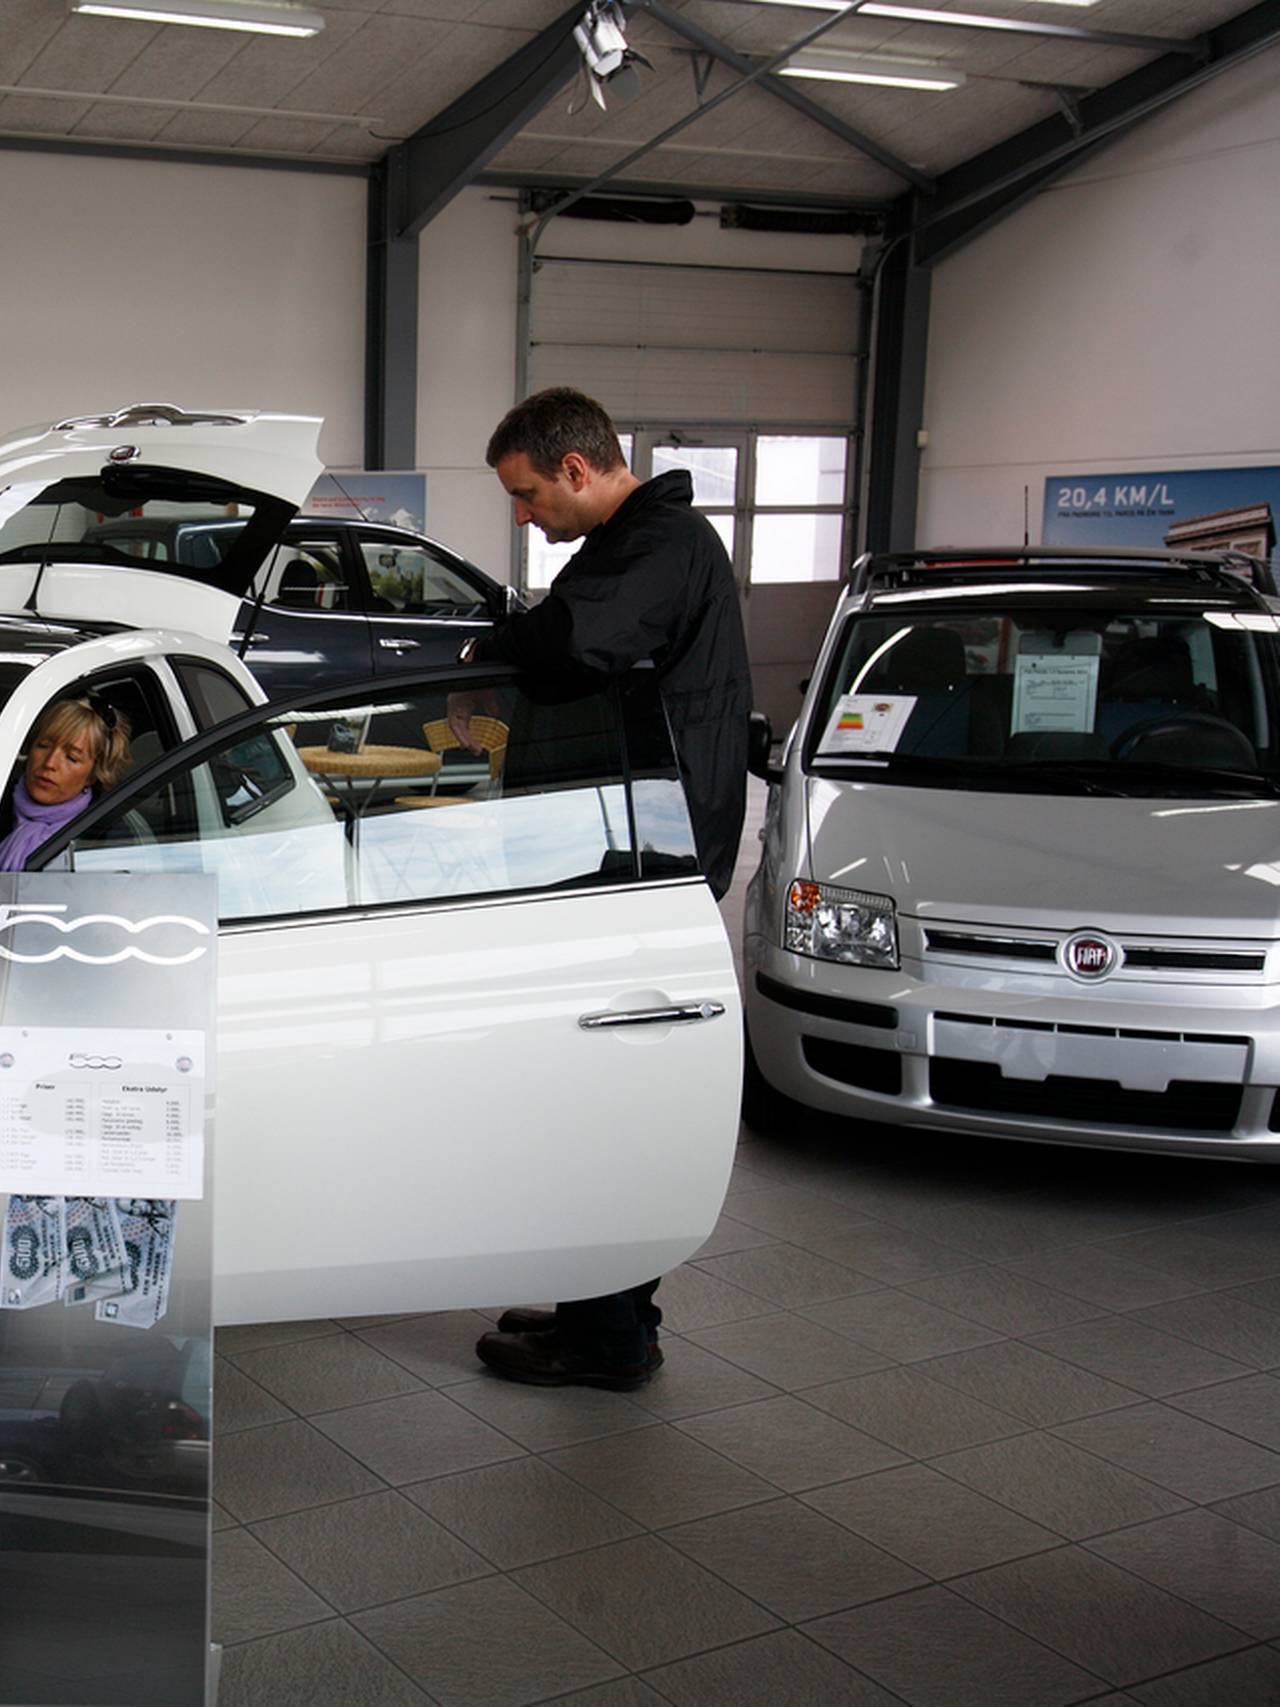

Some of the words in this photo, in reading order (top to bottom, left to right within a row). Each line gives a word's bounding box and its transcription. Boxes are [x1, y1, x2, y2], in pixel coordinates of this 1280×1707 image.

[1057, 487, 1106, 510] 20,4
[1114, 483, 1175, 506] KM/L
[1076, 946, 1107, 966] FIAT
